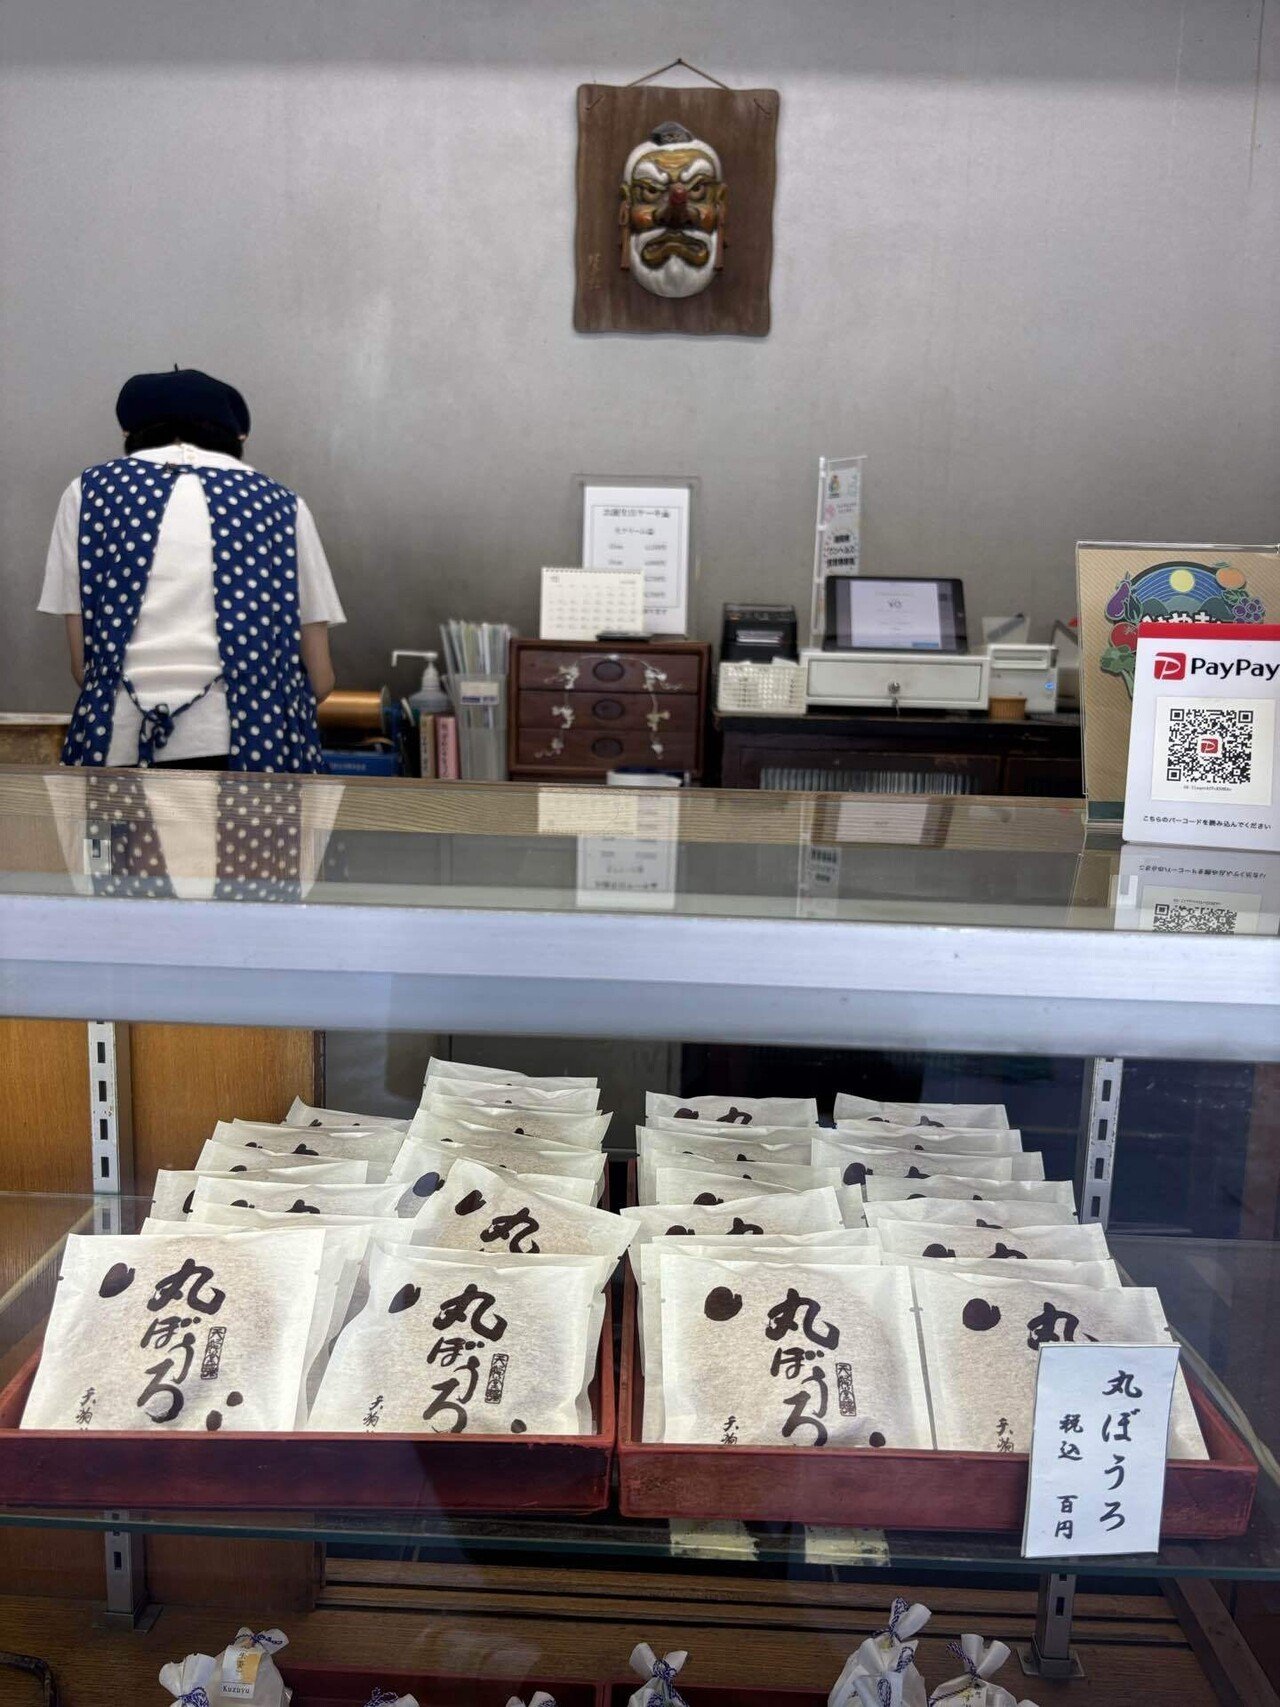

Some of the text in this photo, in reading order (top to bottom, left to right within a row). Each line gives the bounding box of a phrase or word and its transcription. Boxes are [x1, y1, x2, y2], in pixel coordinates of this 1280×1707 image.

[1191, 658, 1280, 681] PayPay
[1143, 815, 1271, 830] こちらのバーコードを読み込んでください
[137, 1258, 226, 1423] 丸ぼうろ
[423, 1284, 507, 1434] 丸ぼうろ
[765, 1288, 840, 1447] 丸ぼうろ
[1054, 1413, 1084, 1540] 税込 百円
[1099, 1370, 1143, 1531] 丸ぼうろ
